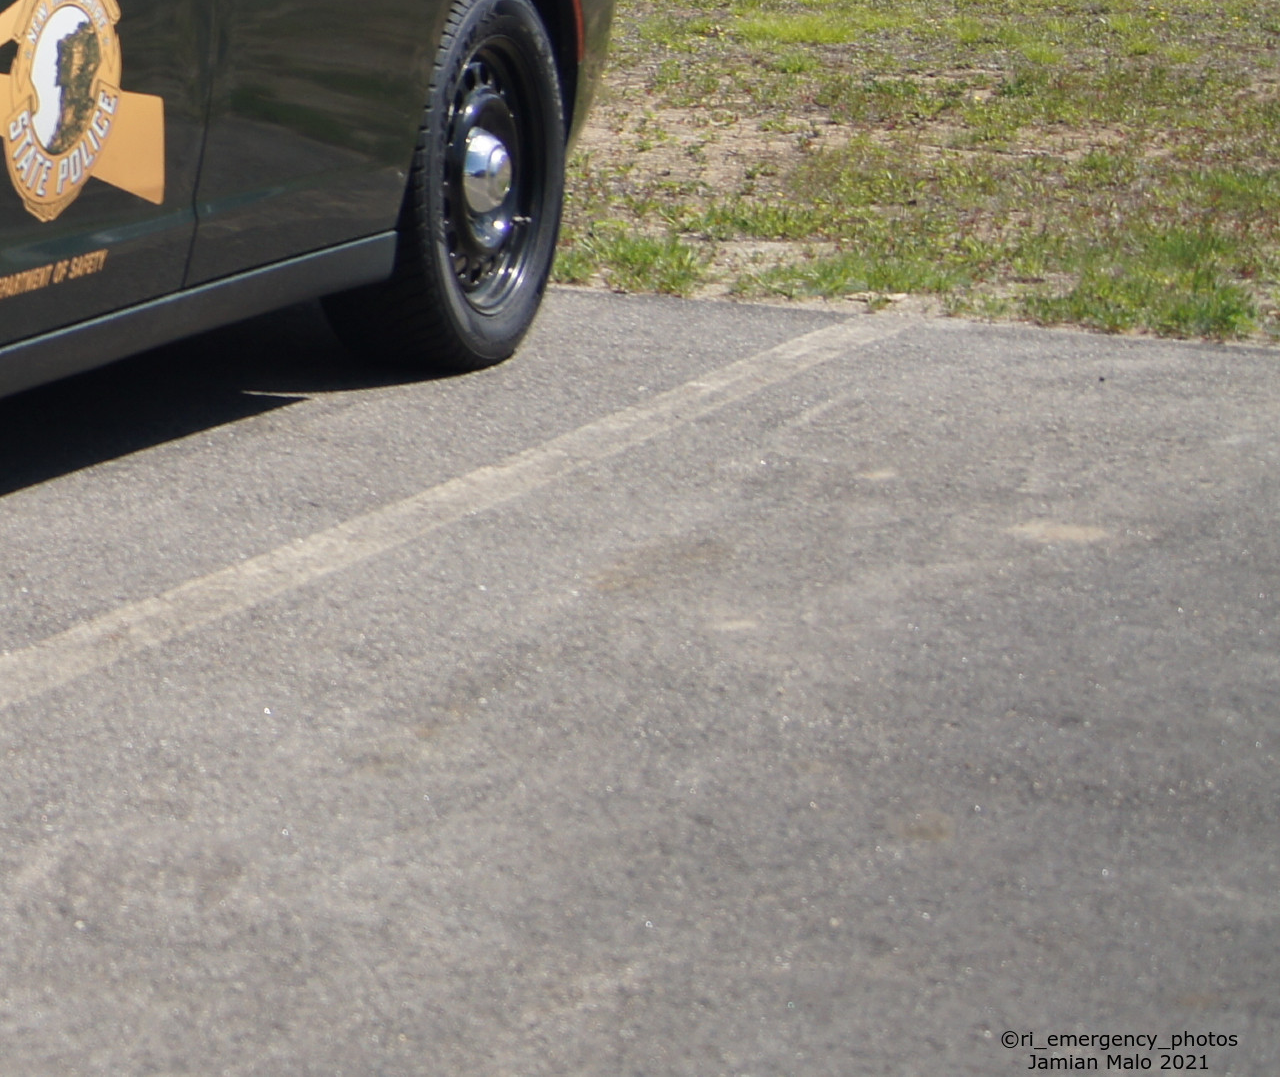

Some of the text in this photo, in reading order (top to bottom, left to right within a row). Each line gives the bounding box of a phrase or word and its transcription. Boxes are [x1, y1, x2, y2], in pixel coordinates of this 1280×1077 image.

[27, 2, 48, 44] NEW
[9, 90, 118, 197] STATE POLICE
[53, 259, 69, 284] OF
[68, 248, 109, 280] SAFETY
